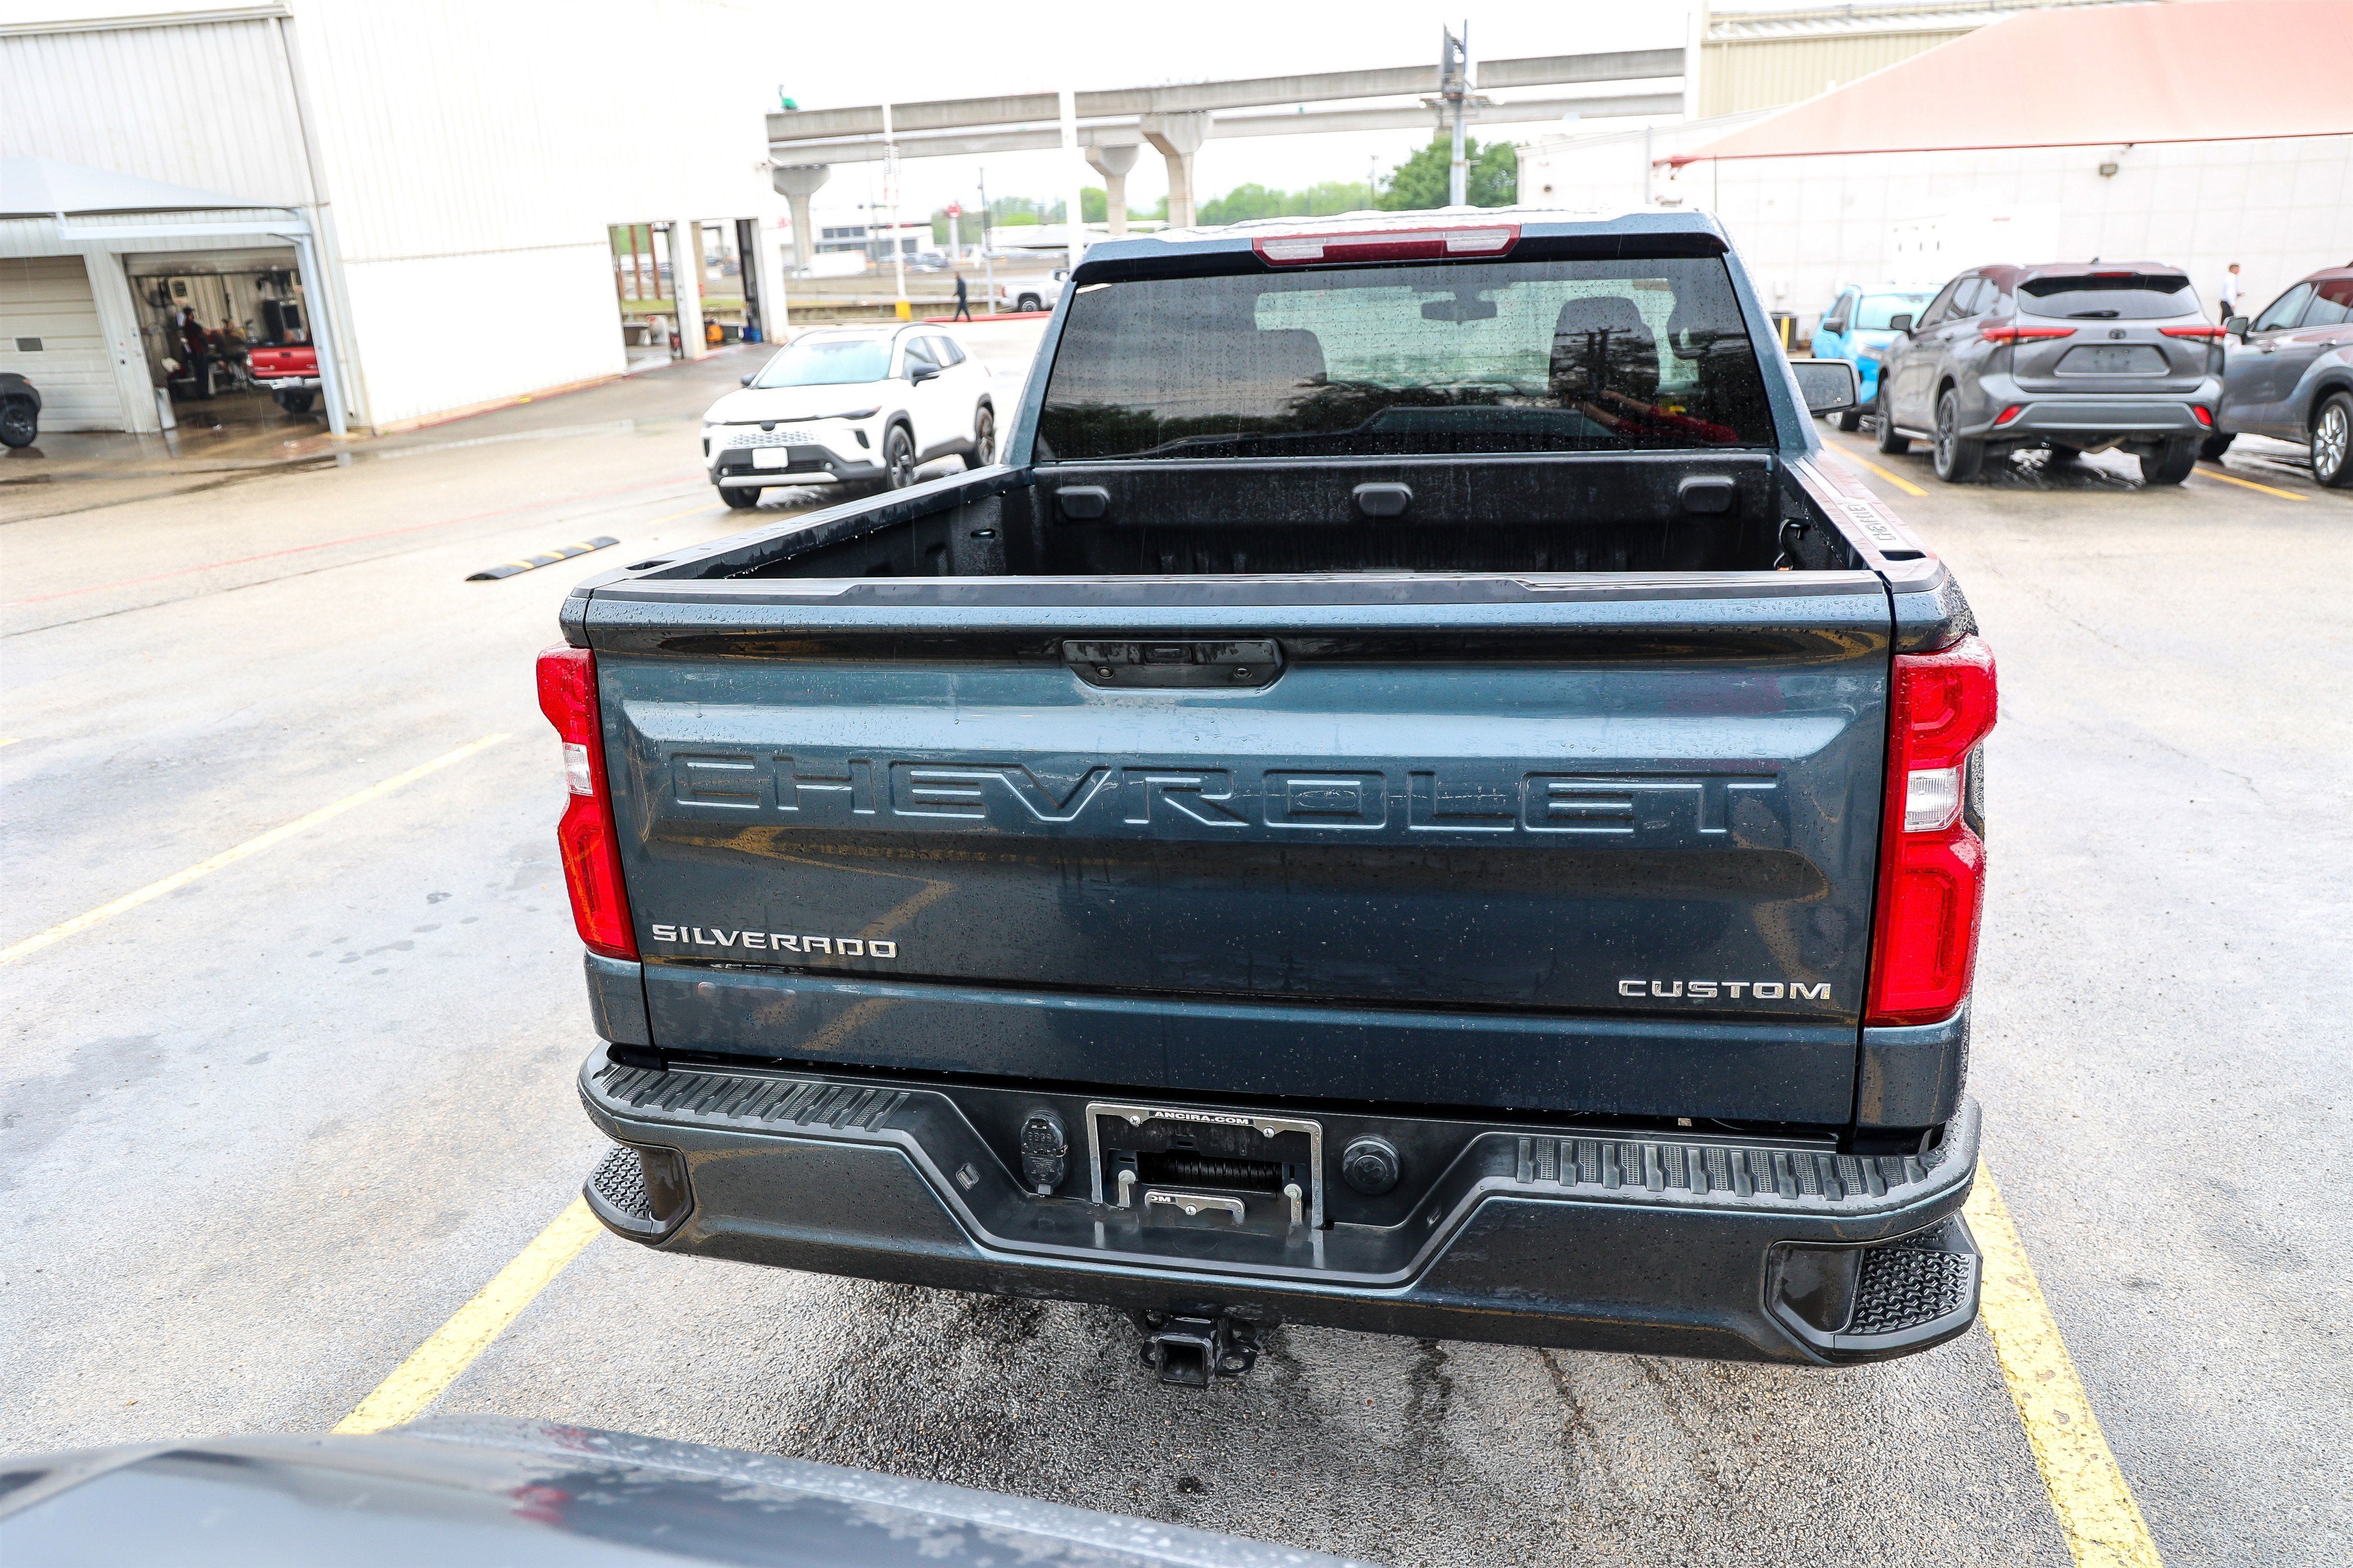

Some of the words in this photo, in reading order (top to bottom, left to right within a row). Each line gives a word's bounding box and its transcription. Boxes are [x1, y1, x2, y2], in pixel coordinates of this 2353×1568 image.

[672, 754, 1777, 833] CHEVROLET
[651, 924, 898, 958] SILVERADO
[1618, 979, 1831, 1000] CUSTOM
[1154, 1111, 1249, 1125] ANCIRA.COM
